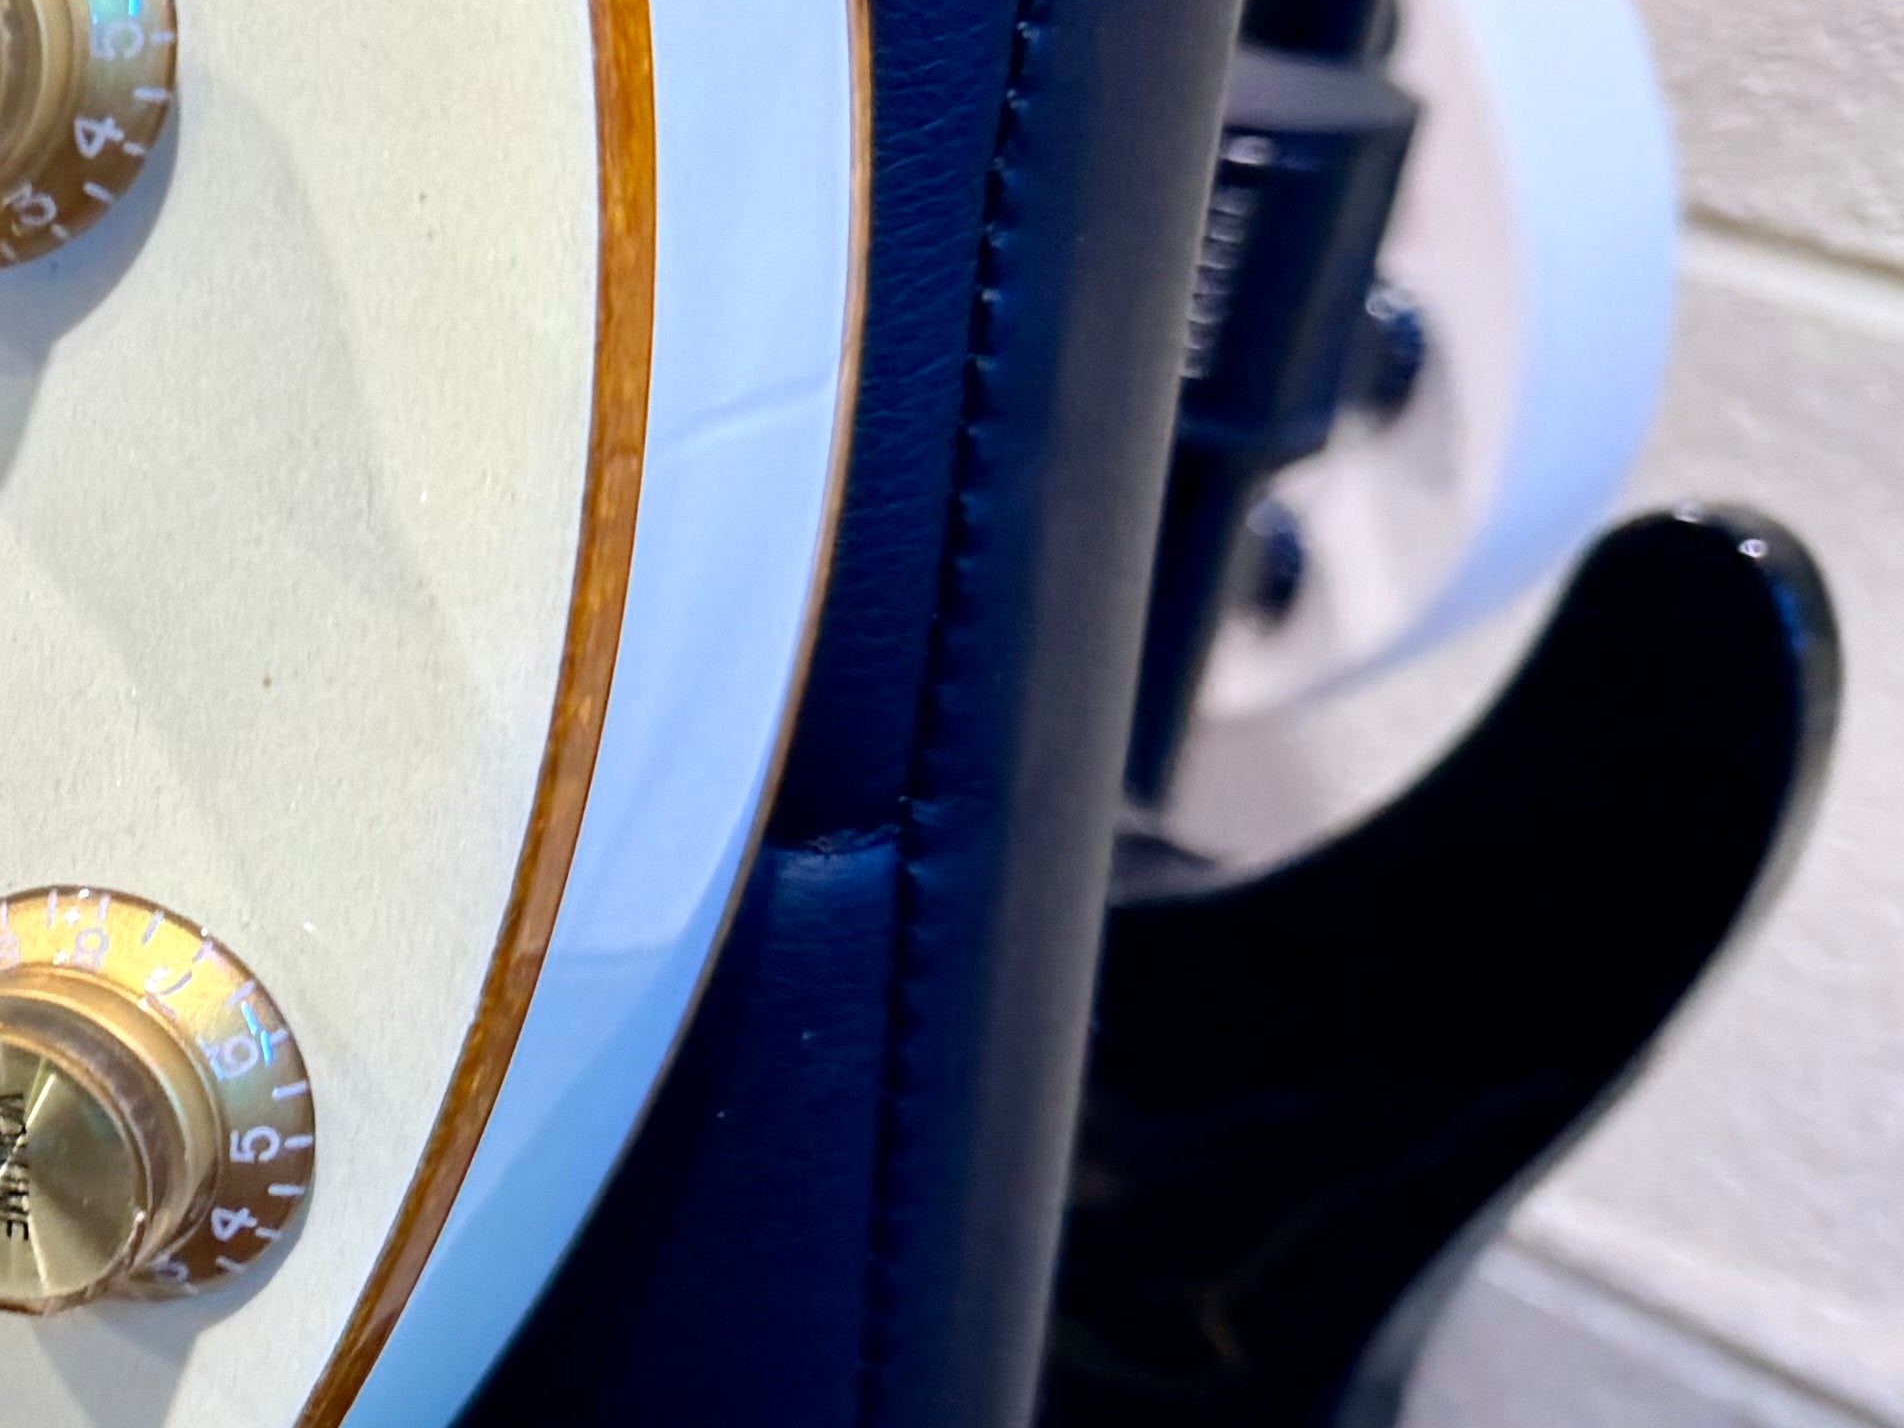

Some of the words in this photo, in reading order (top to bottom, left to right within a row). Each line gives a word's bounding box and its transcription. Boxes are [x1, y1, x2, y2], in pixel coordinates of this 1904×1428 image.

[92, 21, 145, 60] 5
[74, 115, 125, 157] 4
[72, 927, 109, 970] 8
[229, 1125, 280, 1163] 5
[211, 1206, 257, 1241] 4
